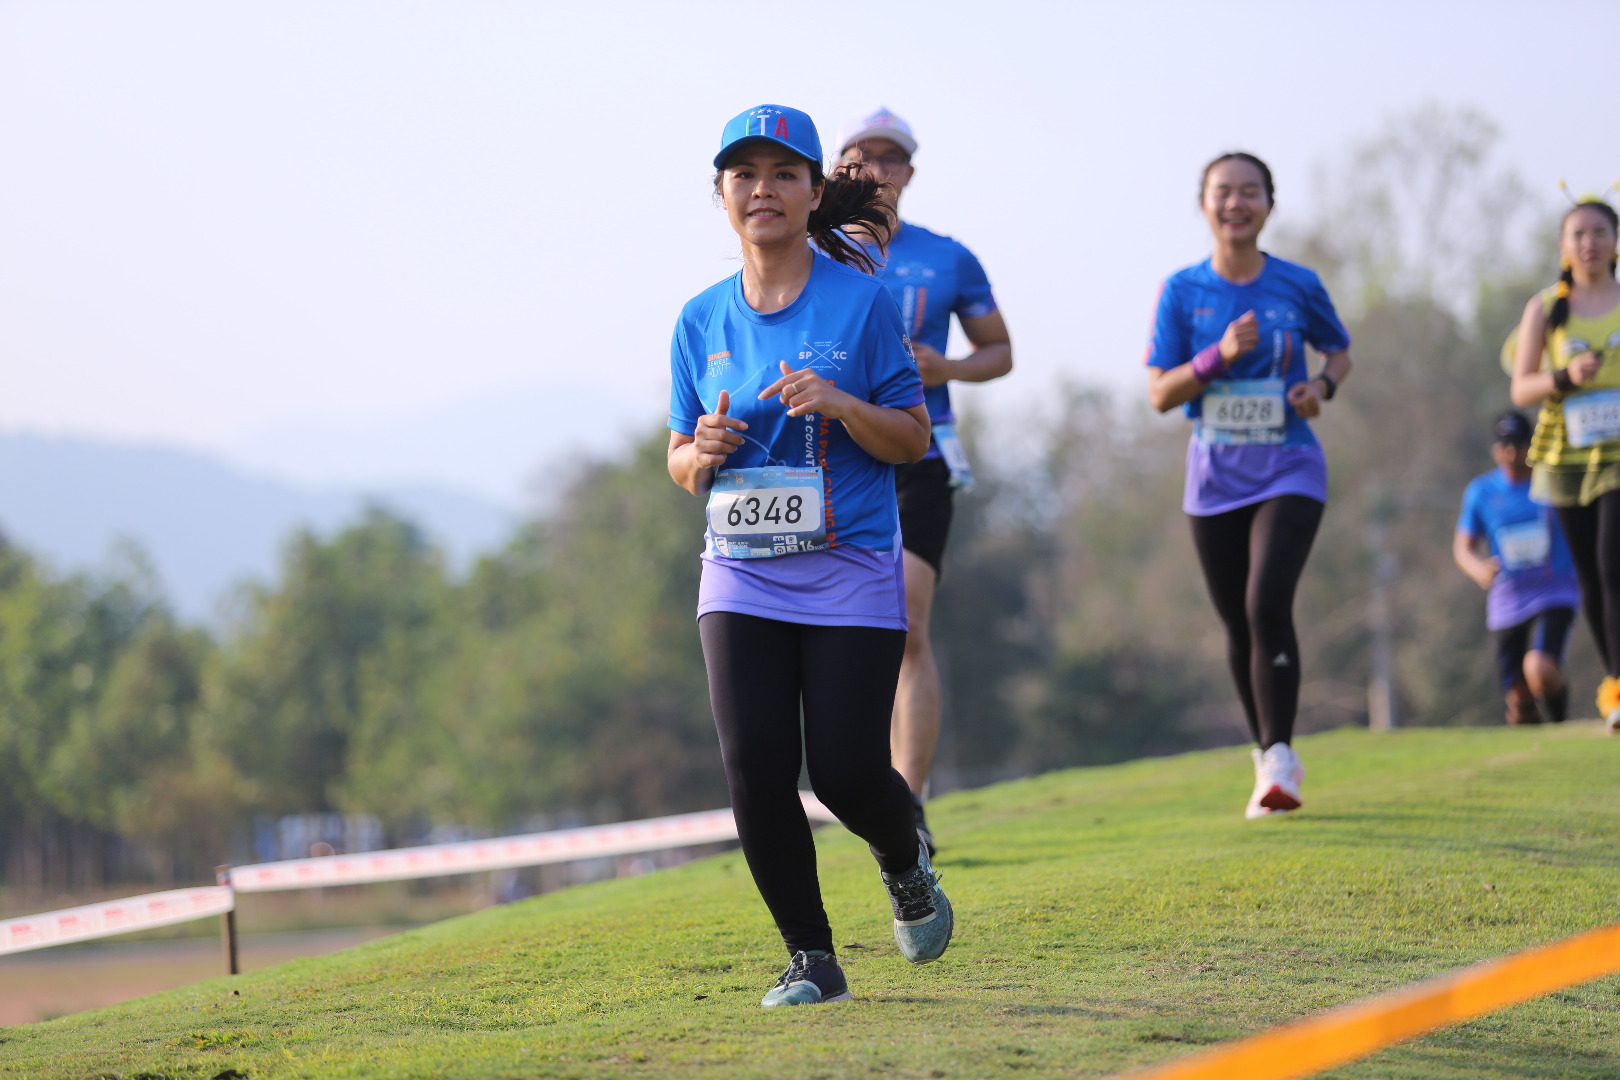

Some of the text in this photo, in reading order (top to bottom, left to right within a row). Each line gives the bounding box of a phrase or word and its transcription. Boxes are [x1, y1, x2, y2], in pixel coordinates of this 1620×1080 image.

[745, 114, 788, 140] ITA
[798, 350, 847, 360] SP XC
[1217, 399, 1273, 423] 6028
[727, 494, 803, 526] 6348
[800, 540, 815, 552] 16
